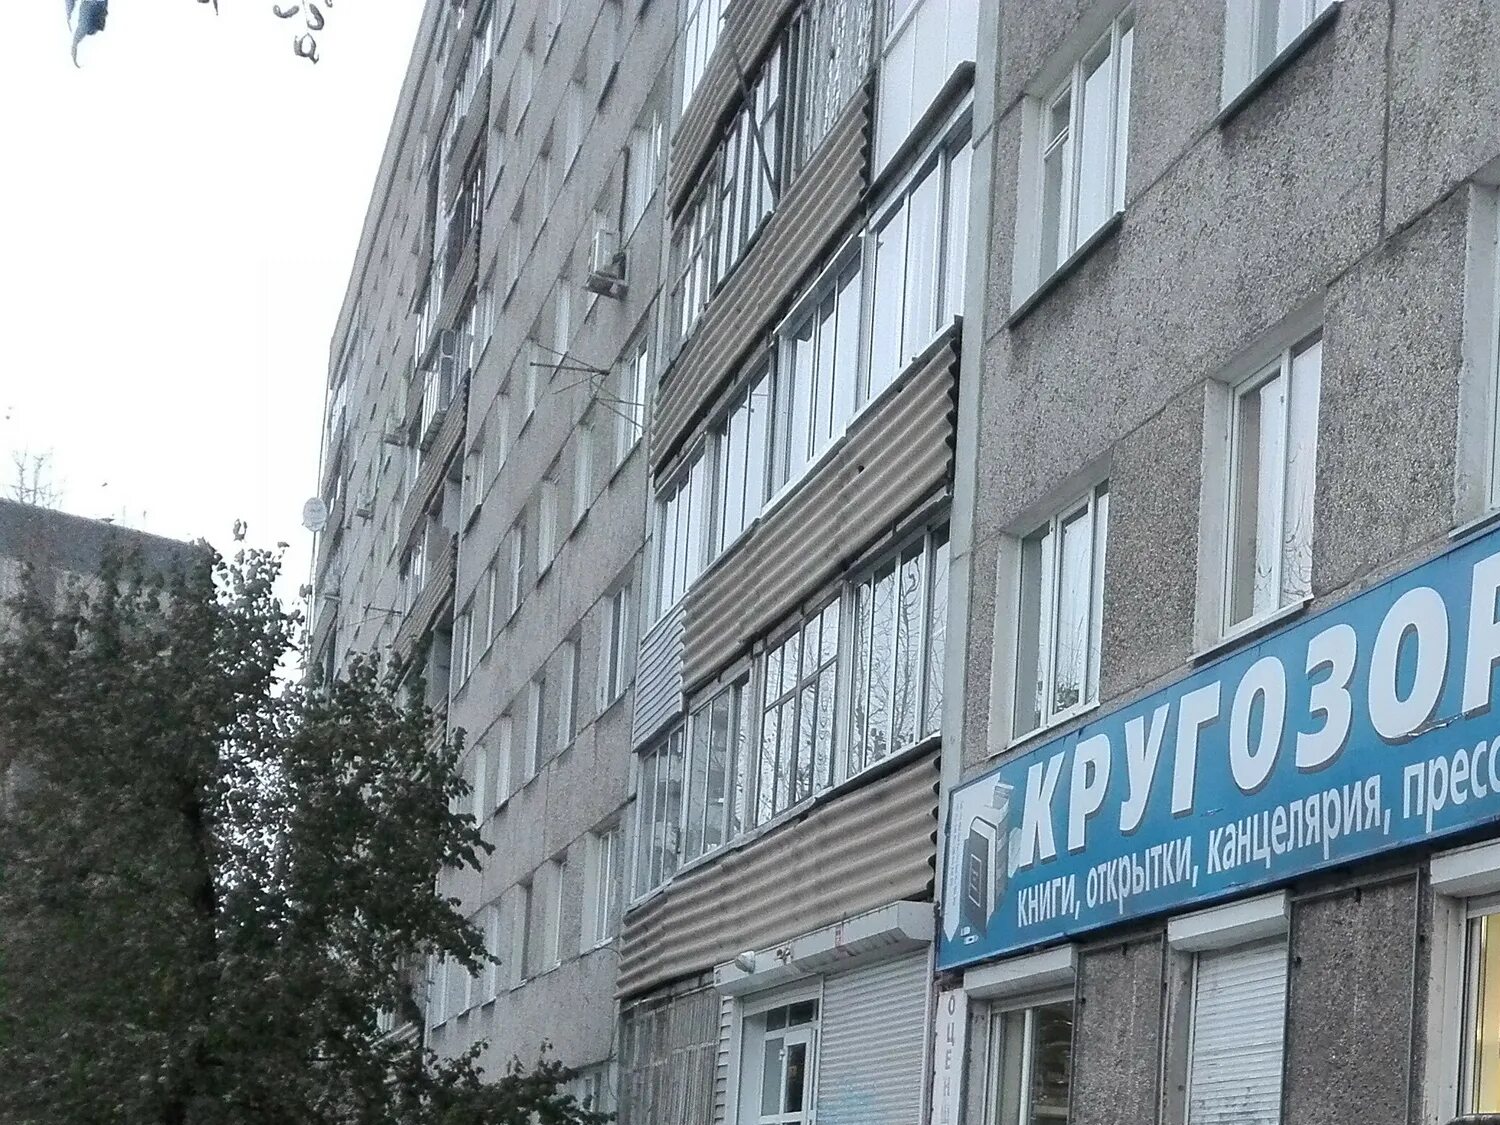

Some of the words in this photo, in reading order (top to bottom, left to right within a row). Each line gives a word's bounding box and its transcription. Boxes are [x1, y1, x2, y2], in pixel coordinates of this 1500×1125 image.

[1018, 873, 1081, 928] книги,
[1086, 836, 1199, 914] открытки,
[1207, 774, 1391, 874] канцелярия,
